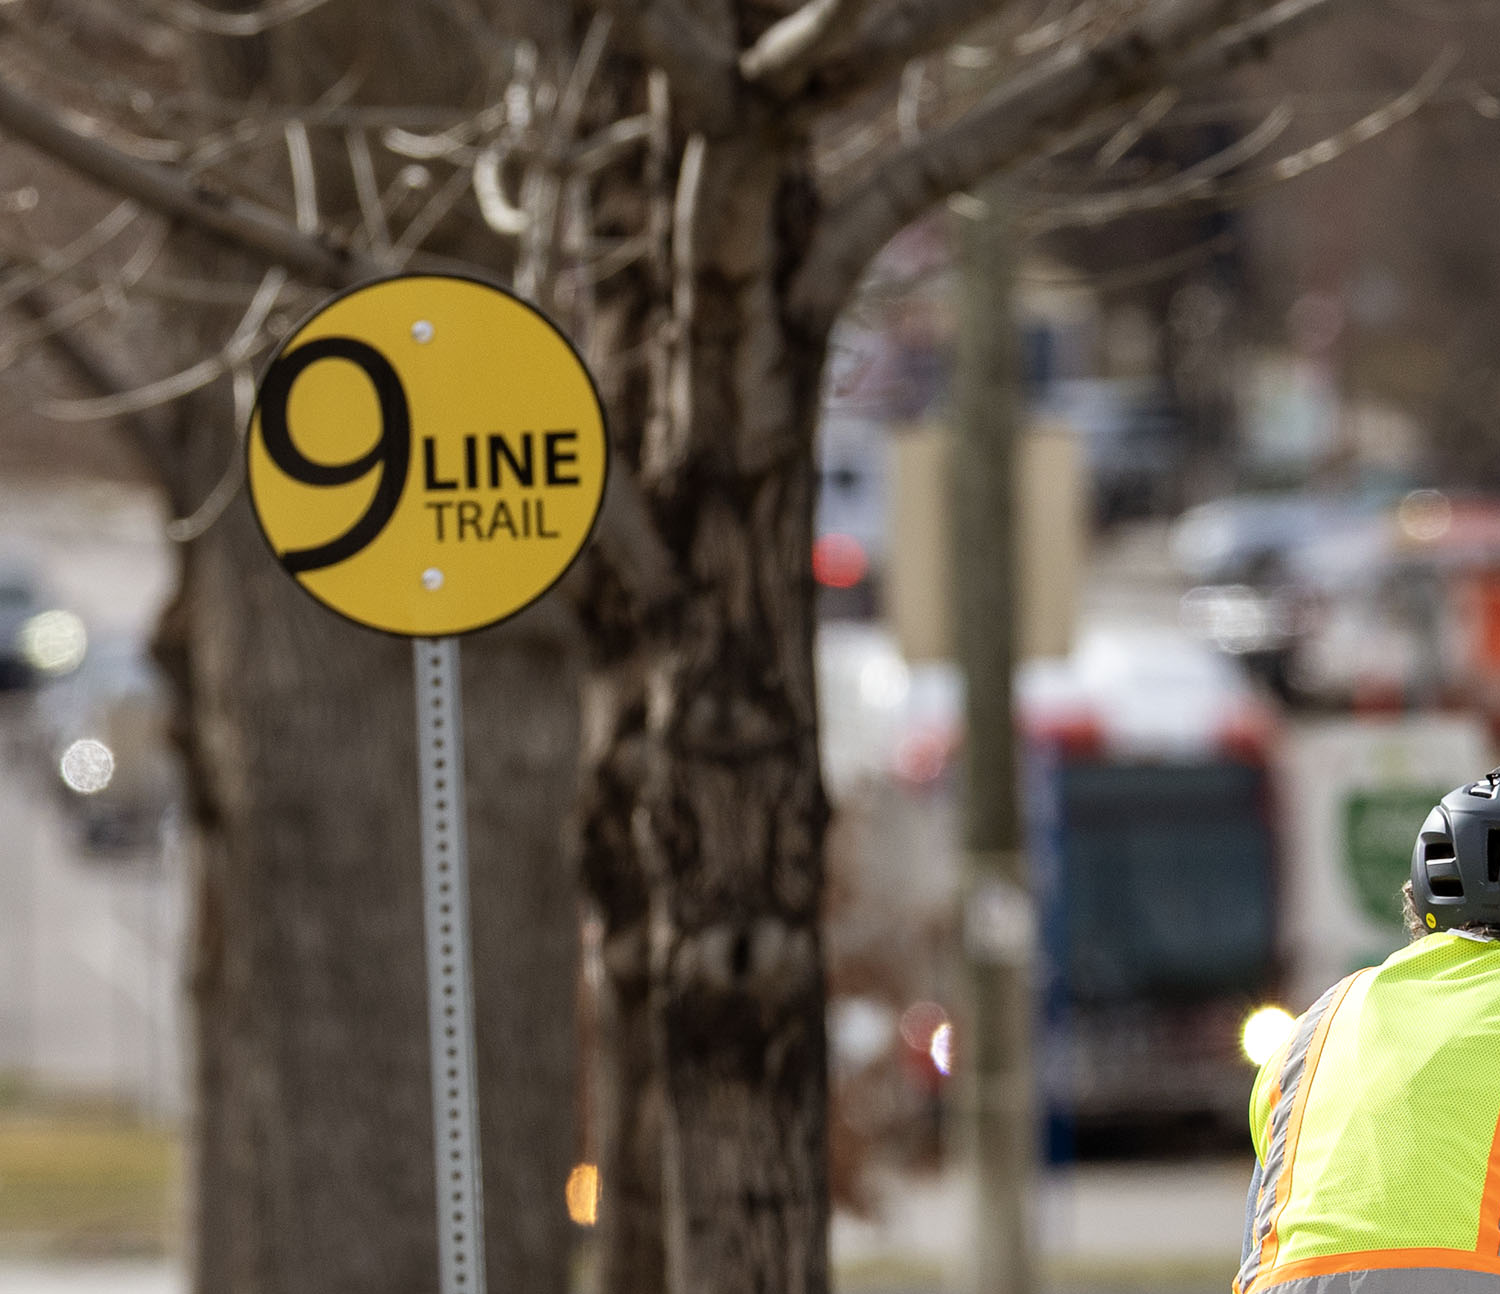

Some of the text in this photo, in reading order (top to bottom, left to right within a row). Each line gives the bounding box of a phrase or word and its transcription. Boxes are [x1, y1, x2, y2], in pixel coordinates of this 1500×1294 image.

[257, 336, 581, 574] 9 LINE
[424, 498, 560, 543] TRAIL
